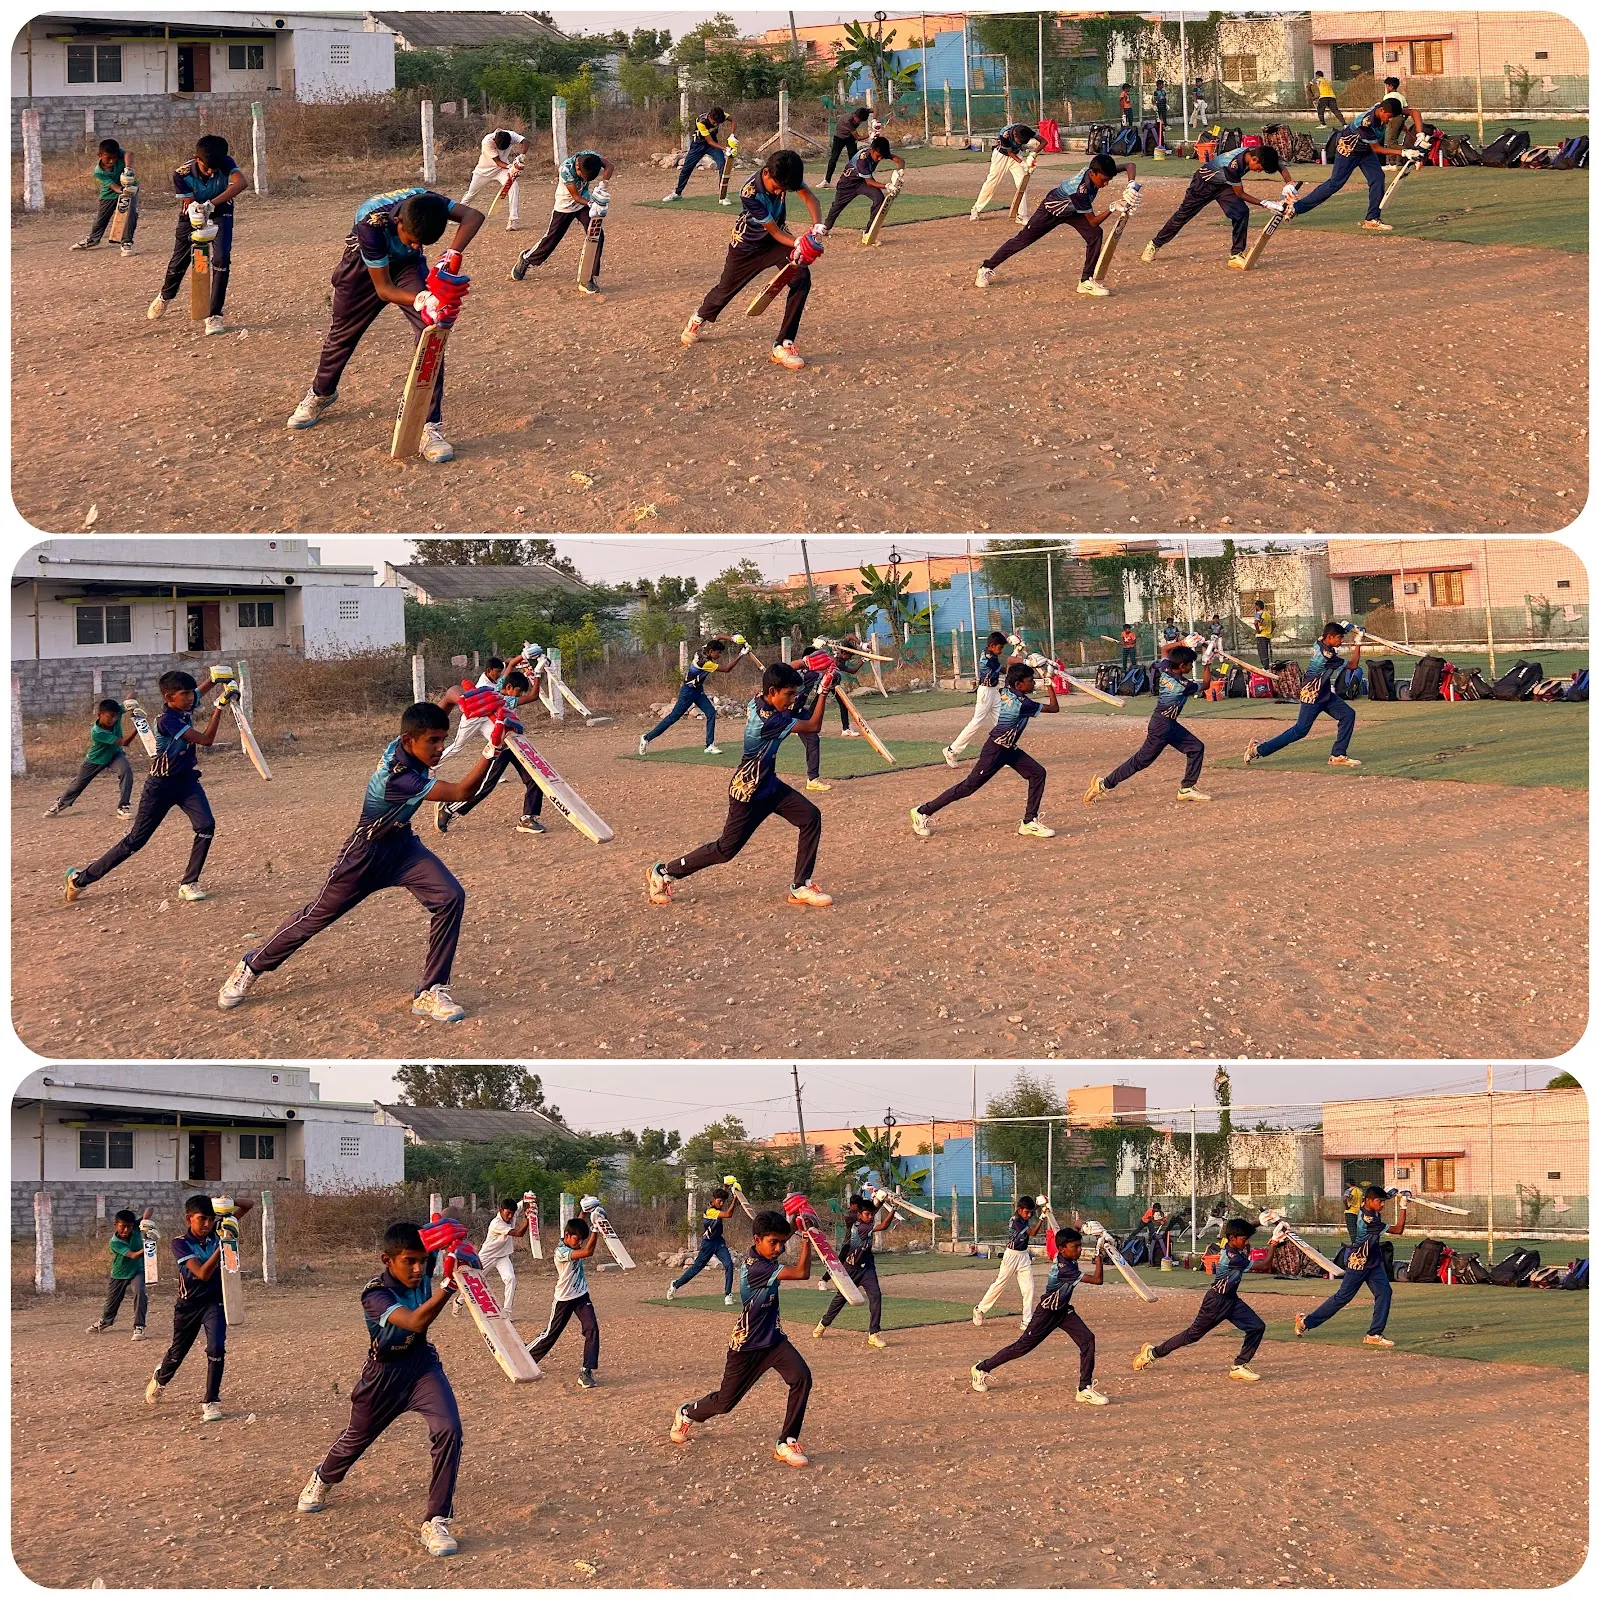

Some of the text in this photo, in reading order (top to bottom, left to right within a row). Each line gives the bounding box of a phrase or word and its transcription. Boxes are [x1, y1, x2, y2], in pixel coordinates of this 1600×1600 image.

[415, 347, 426, 371] Genius
[416, 332, 442, 382] MRF
[513, 738, 556, 778] MRF
[549, 795, 571, 817] MRF
[598, 1220, 615, 1235] SS
[462, 1272, 498, 1314] MRF
[464, 1284, 477, 1305] Genius
